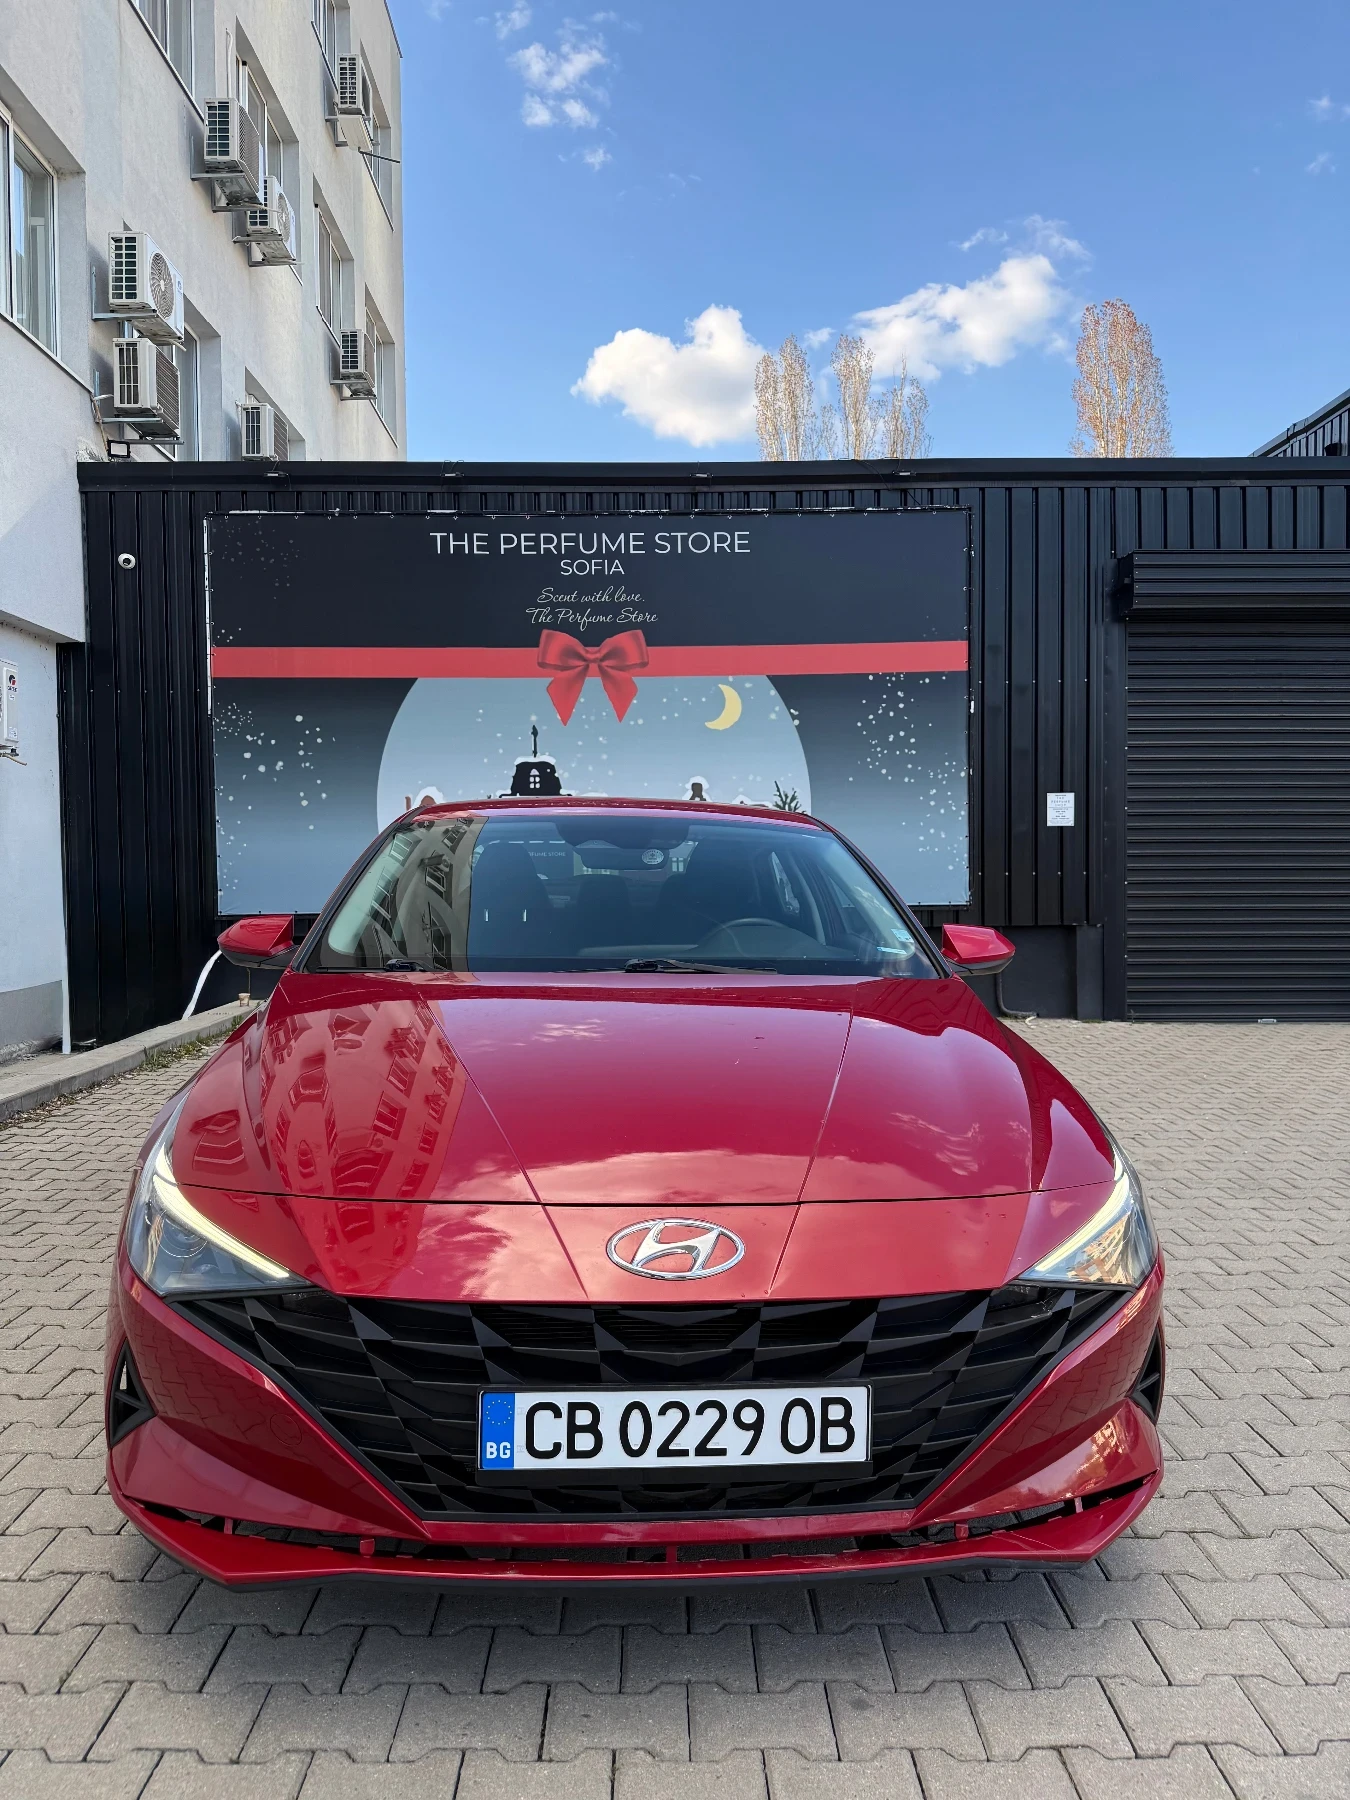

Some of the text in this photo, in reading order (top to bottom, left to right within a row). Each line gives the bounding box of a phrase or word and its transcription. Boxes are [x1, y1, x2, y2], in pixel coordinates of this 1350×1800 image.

[430, 531, 750, 555] THE PERFUME STORE
[560, 559, 625, 576] SOFIA
[537, 586, 645, 603] Scent with love.
[525, 607, 659, 631] The Perfume Store
[524, 1396, 855, 1460] CB 0229 OB
[486, 1441, 511, 1459] BG
